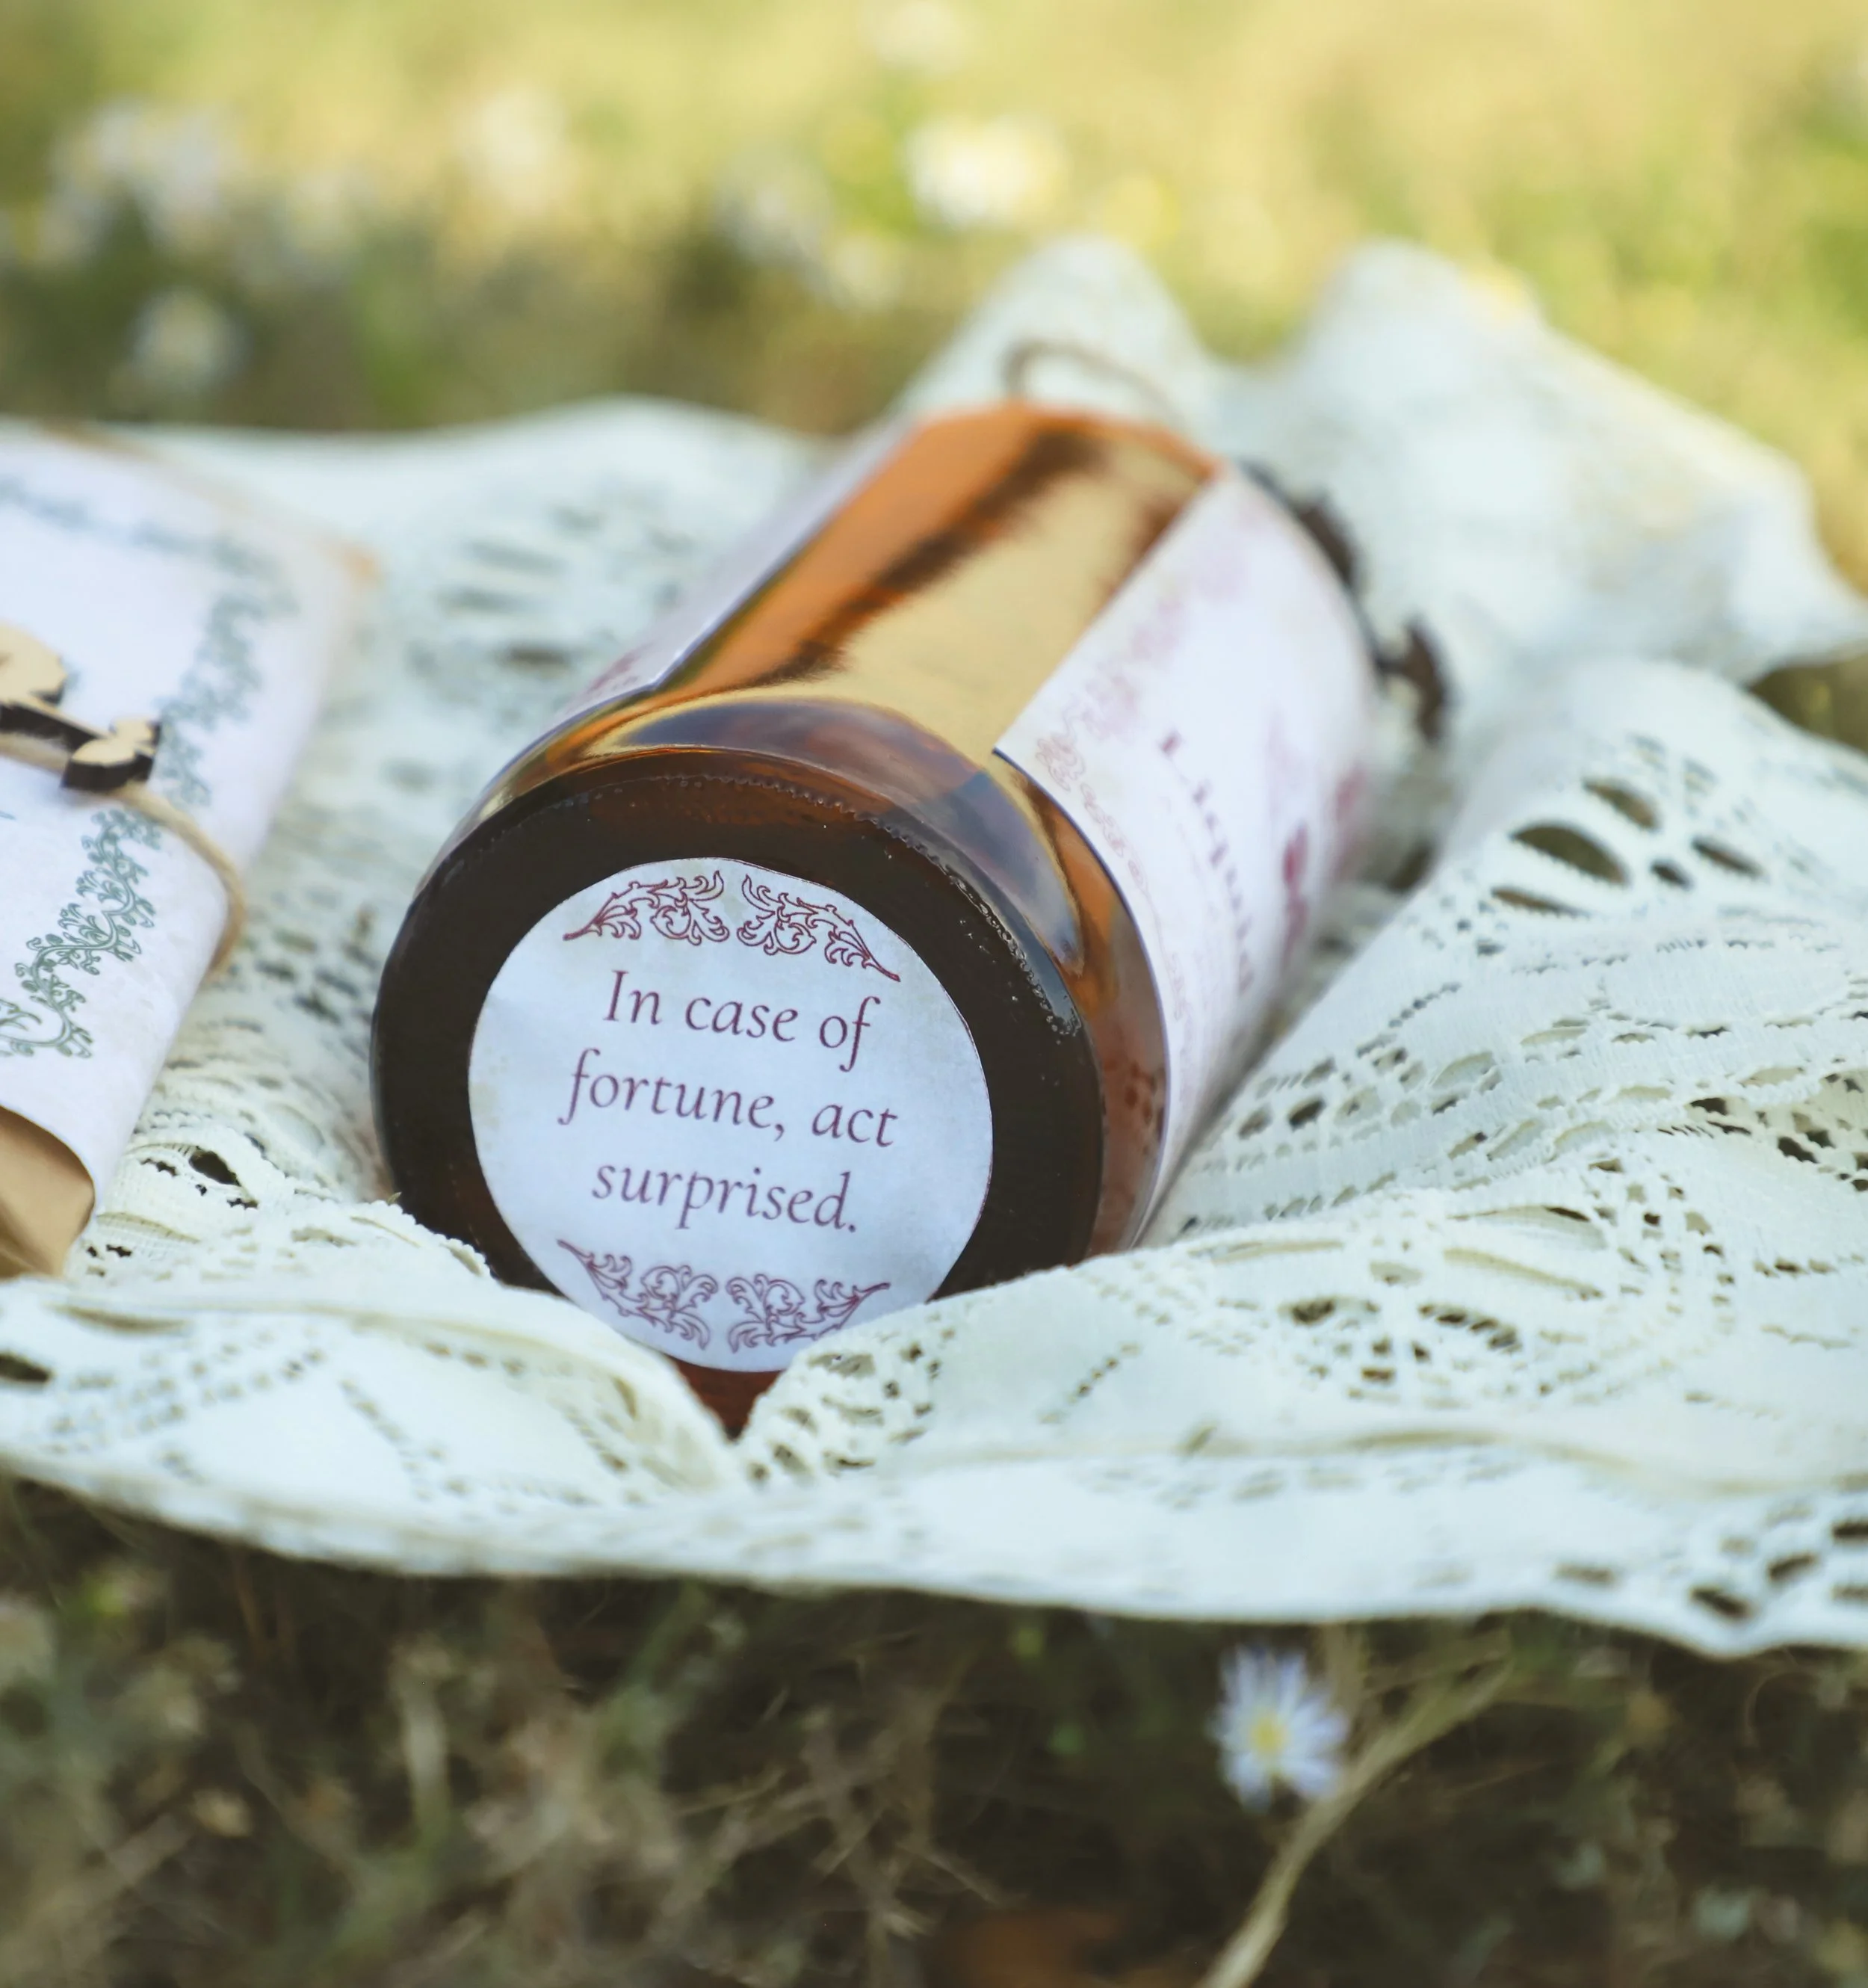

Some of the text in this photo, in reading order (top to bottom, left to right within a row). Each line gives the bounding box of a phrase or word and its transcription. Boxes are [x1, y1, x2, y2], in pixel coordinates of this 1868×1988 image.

[603, 970, 880, 1072] In case of
[557, 1049, 898, 1146] fortune, act
[593, 1164, 856, 1232] surprised.
